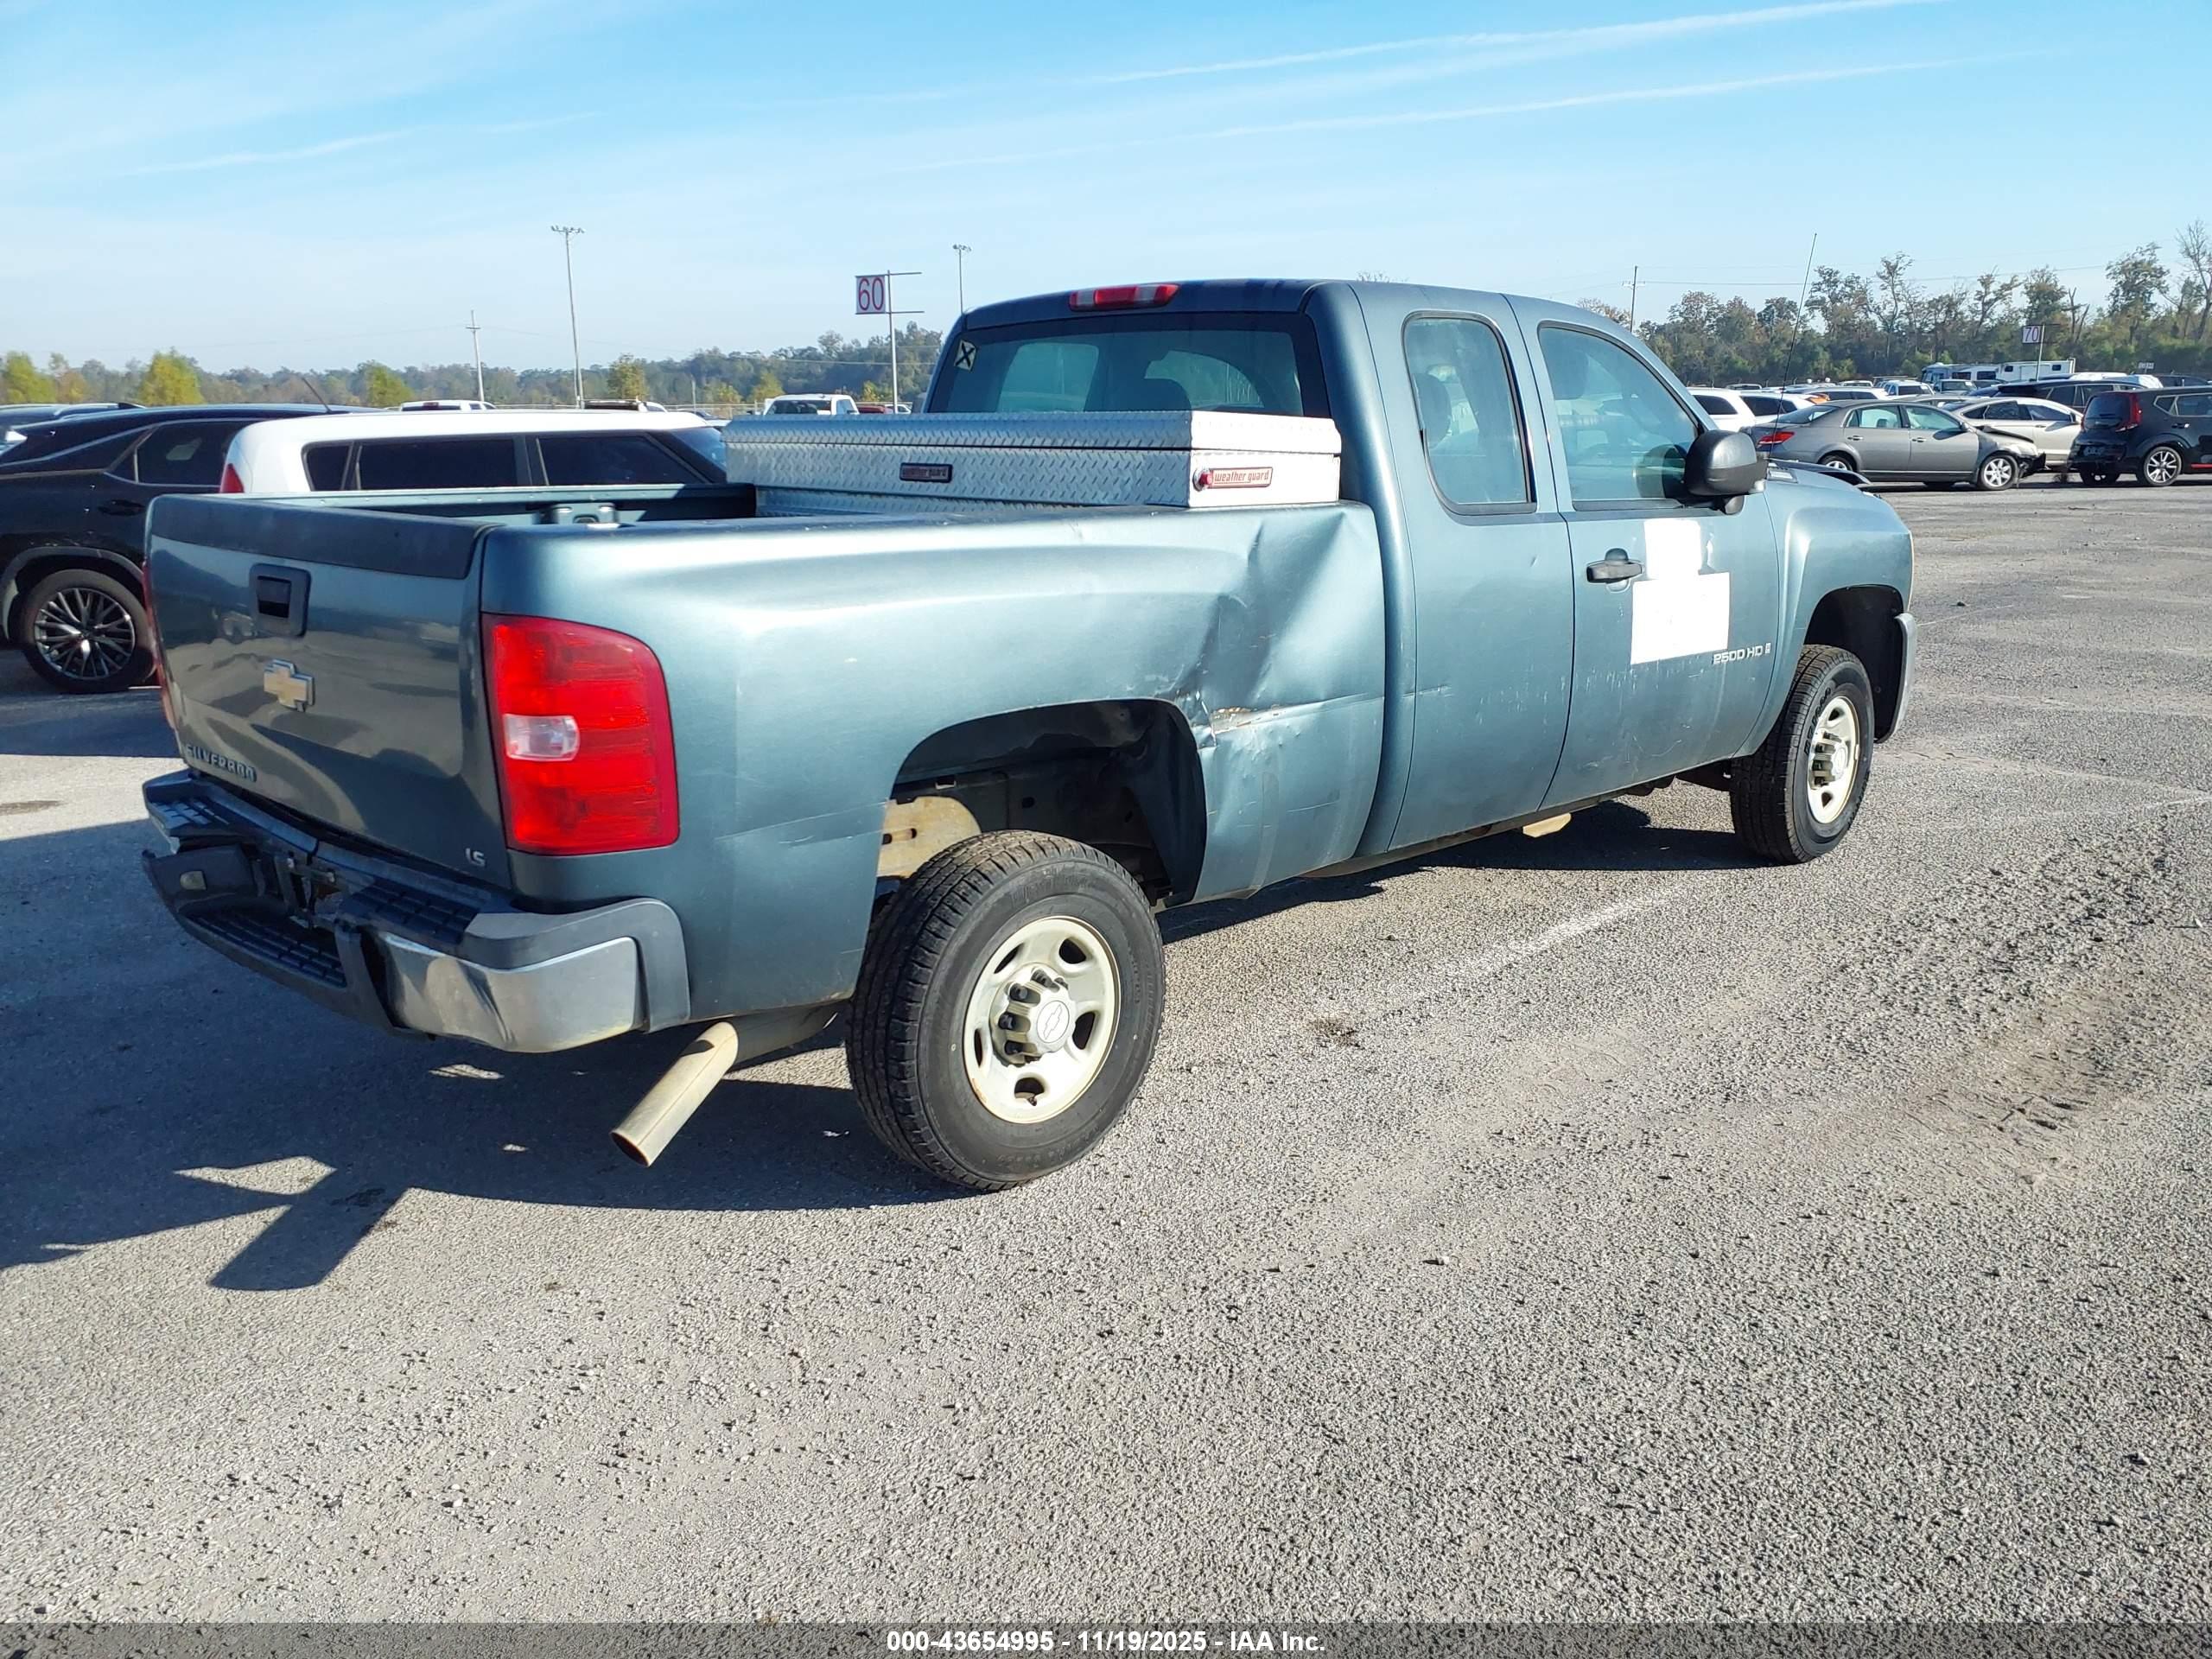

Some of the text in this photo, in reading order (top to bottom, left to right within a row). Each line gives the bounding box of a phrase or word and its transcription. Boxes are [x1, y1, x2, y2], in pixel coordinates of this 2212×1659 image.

[858, 276, 884, 311] 60
[2024, 326, 2039, 342] 70
[1214, 470, 1270, 483] weather guard
[1713, 649, 1745, 664] 2500
[1746, 645, 1764, 658] HD
[465, 847, 486, 868] LS
